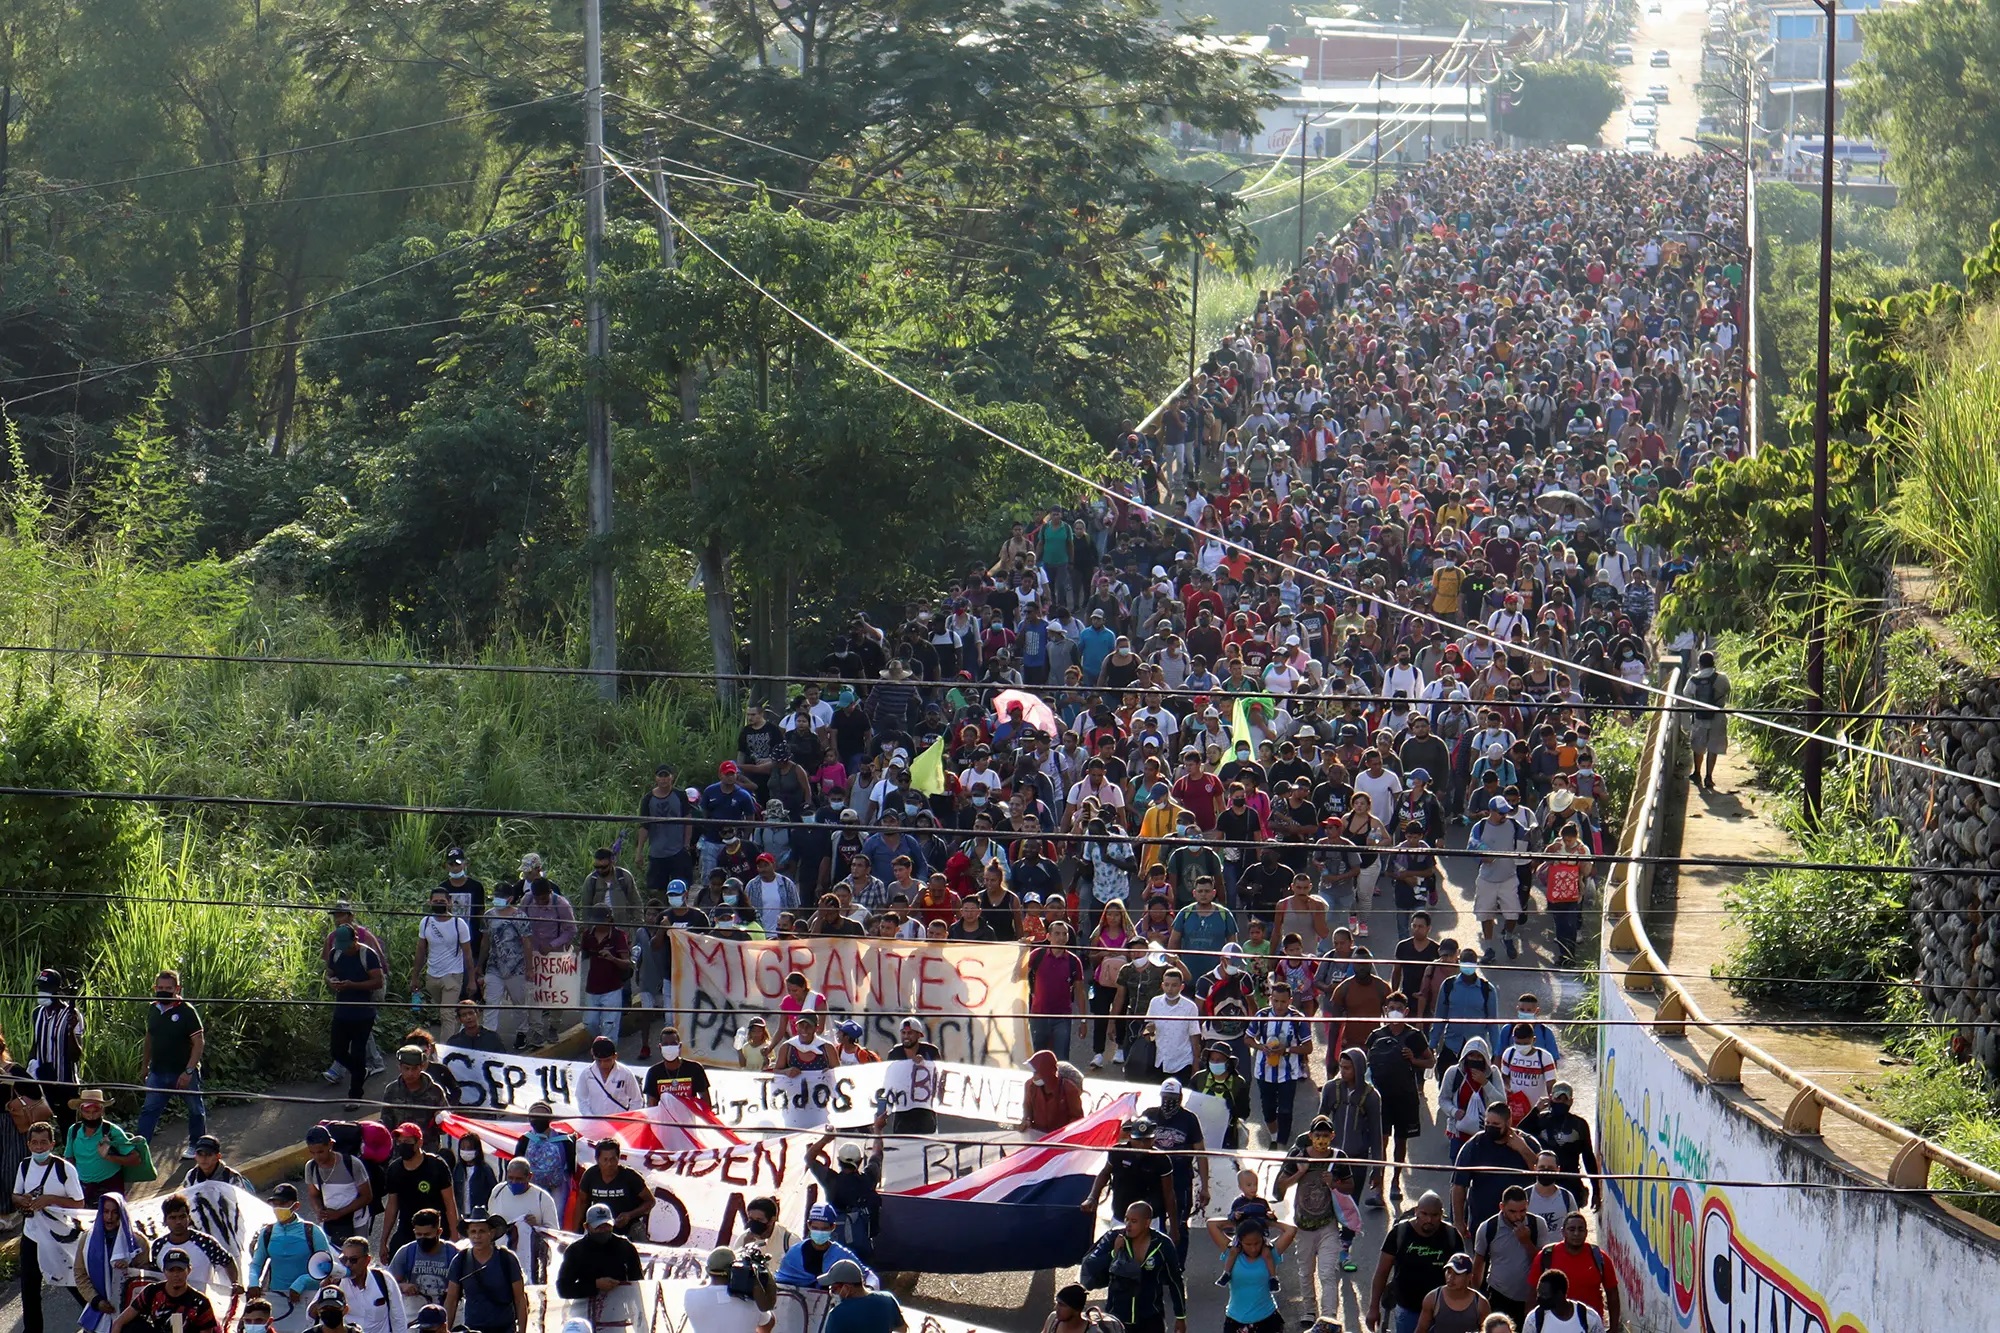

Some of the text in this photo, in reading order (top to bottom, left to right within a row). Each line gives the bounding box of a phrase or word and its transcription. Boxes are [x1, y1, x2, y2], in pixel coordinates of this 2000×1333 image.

[533, 953, 578, 977] PRESIÓN
[687, 934, 989, 1011] MIGRANTES
[534, 990, 569, 1004] NTES
[443, 1052, 571, 1108] SEP 14
